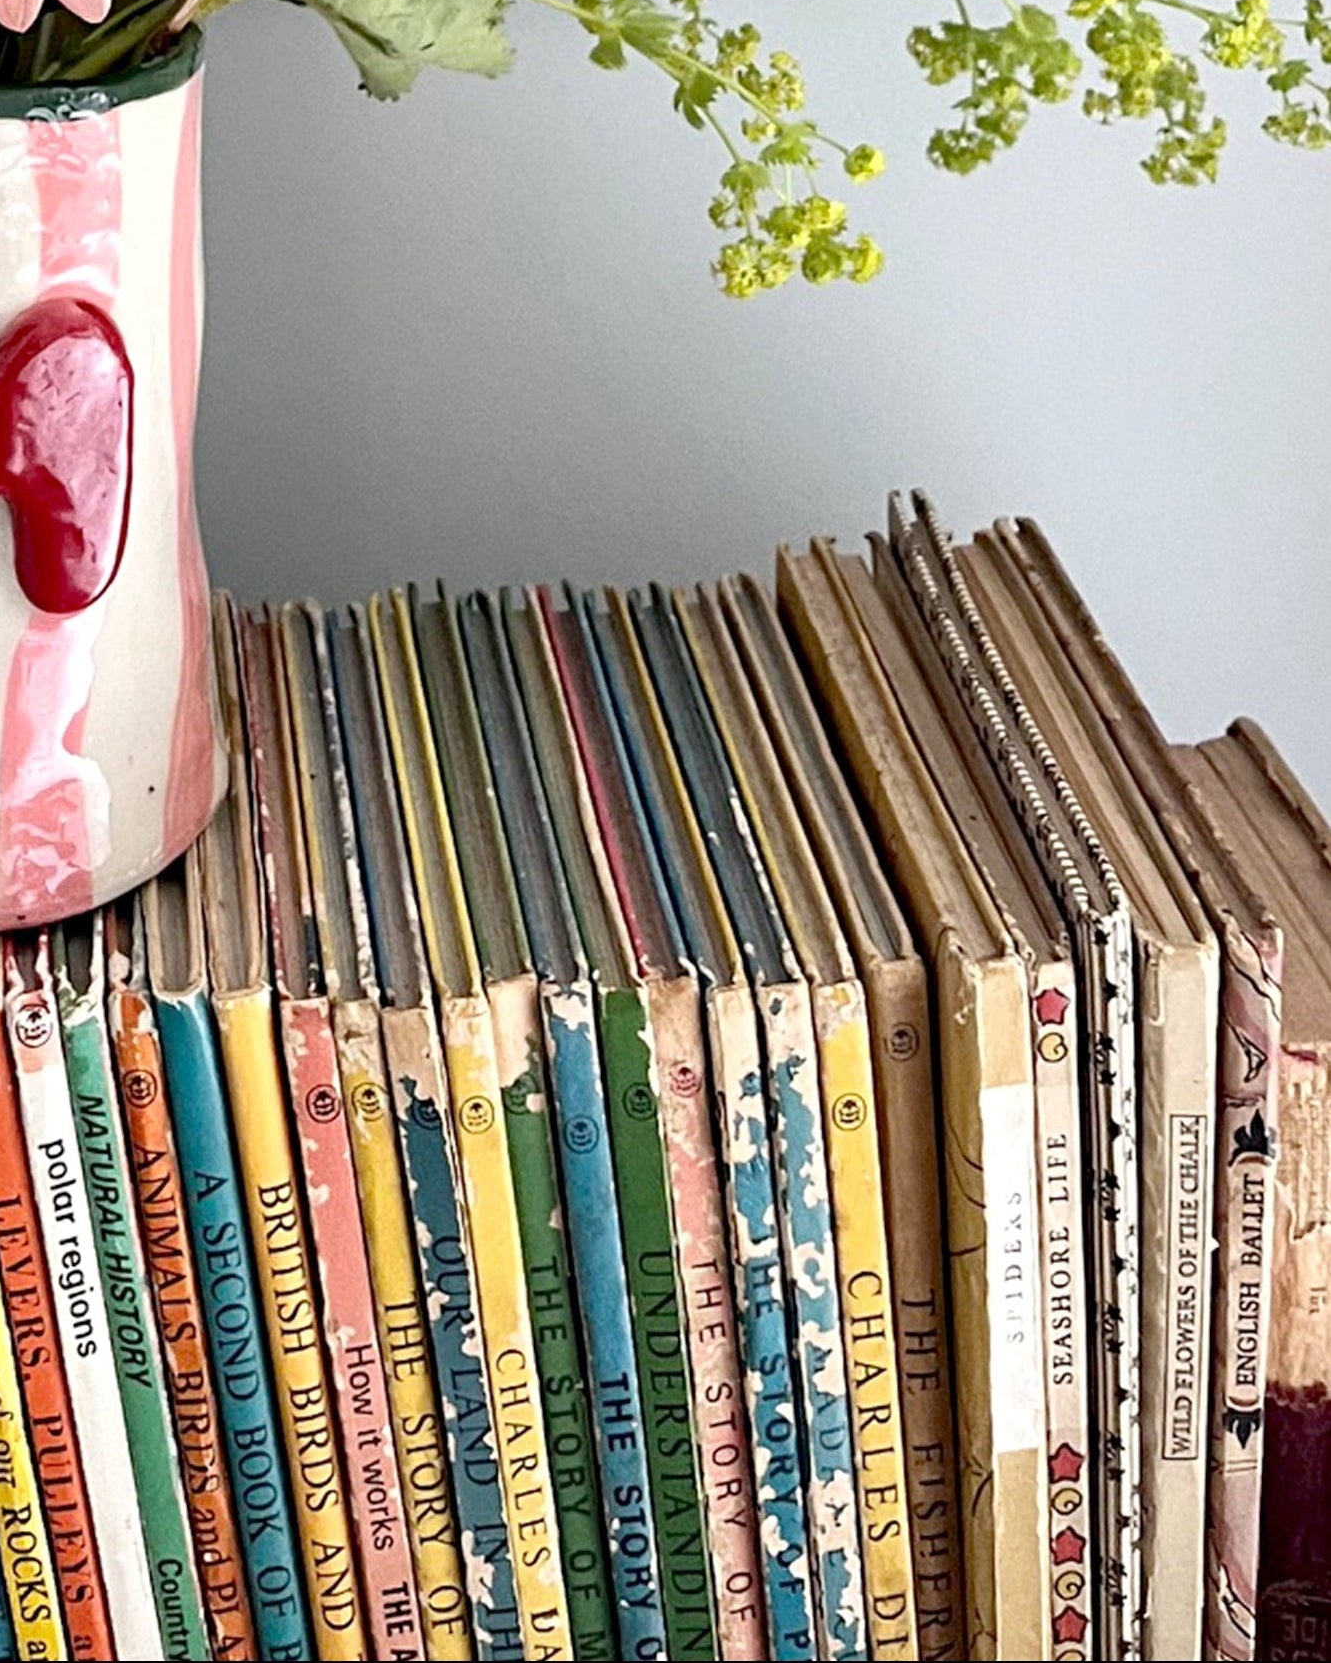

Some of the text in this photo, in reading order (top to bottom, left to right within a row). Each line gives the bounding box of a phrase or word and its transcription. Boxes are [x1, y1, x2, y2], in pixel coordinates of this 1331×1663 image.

[38, 1139, 99, 1359] polar regions
[76, 1094, 126, 1243] NATURAL
[104, 1252, 152, 1388] HISTORY
[135, 1146, 197, 1345] ANIMALS
[193, 1171, 230, 1202] A
[1047, 1133, 1073, 1385] SEASHORE LIFE
[203, 1221, 261, 1401] SECOND
[432, 1238, 476, 1330] OUR
[901, 1288, 940, 1395] THE
[1172, 1119, 1200, 1456] WILD FLOWERS OF THE CHALK
[1236, 1174, 1266, 1387] ENGLISH BALLET
[174, 1370, 220, 1496] BIRDS
[231, 1425, 284, 1544] BOOK
[256, 1180, 355, 1632] BRITISH BIRDS AND
[344, 1343, 400, 1552] How it works
[384, 1301, 467, 1637] THE STORY OF
[449, 1368, 499, 1486] LAND
[496, 1348, 552, 1568] CHARLES
[531, 1255, 609, 1659] THE STORY OF M
[599, 1372, 637, 1454] THE
[691, 1258, 757, 1622] THE STORY OF
[759, 1353, 798, 1507] STORY
[847, 1270, 910, 1650] CHARLES DI
[1, 1506, 53, 1632] ROCKS
[32, 1414, 95, 1607] PULLEYS
[191, 1508, 233, 1569] and
[256, 1565, 299, 1618] OF
[473, 1523, 512, 1564] IN
[613, 1485, 658, 1611] STORY
[776, 1544, 806, 1597] OF
[381, 1580, 416, 1638] THE
